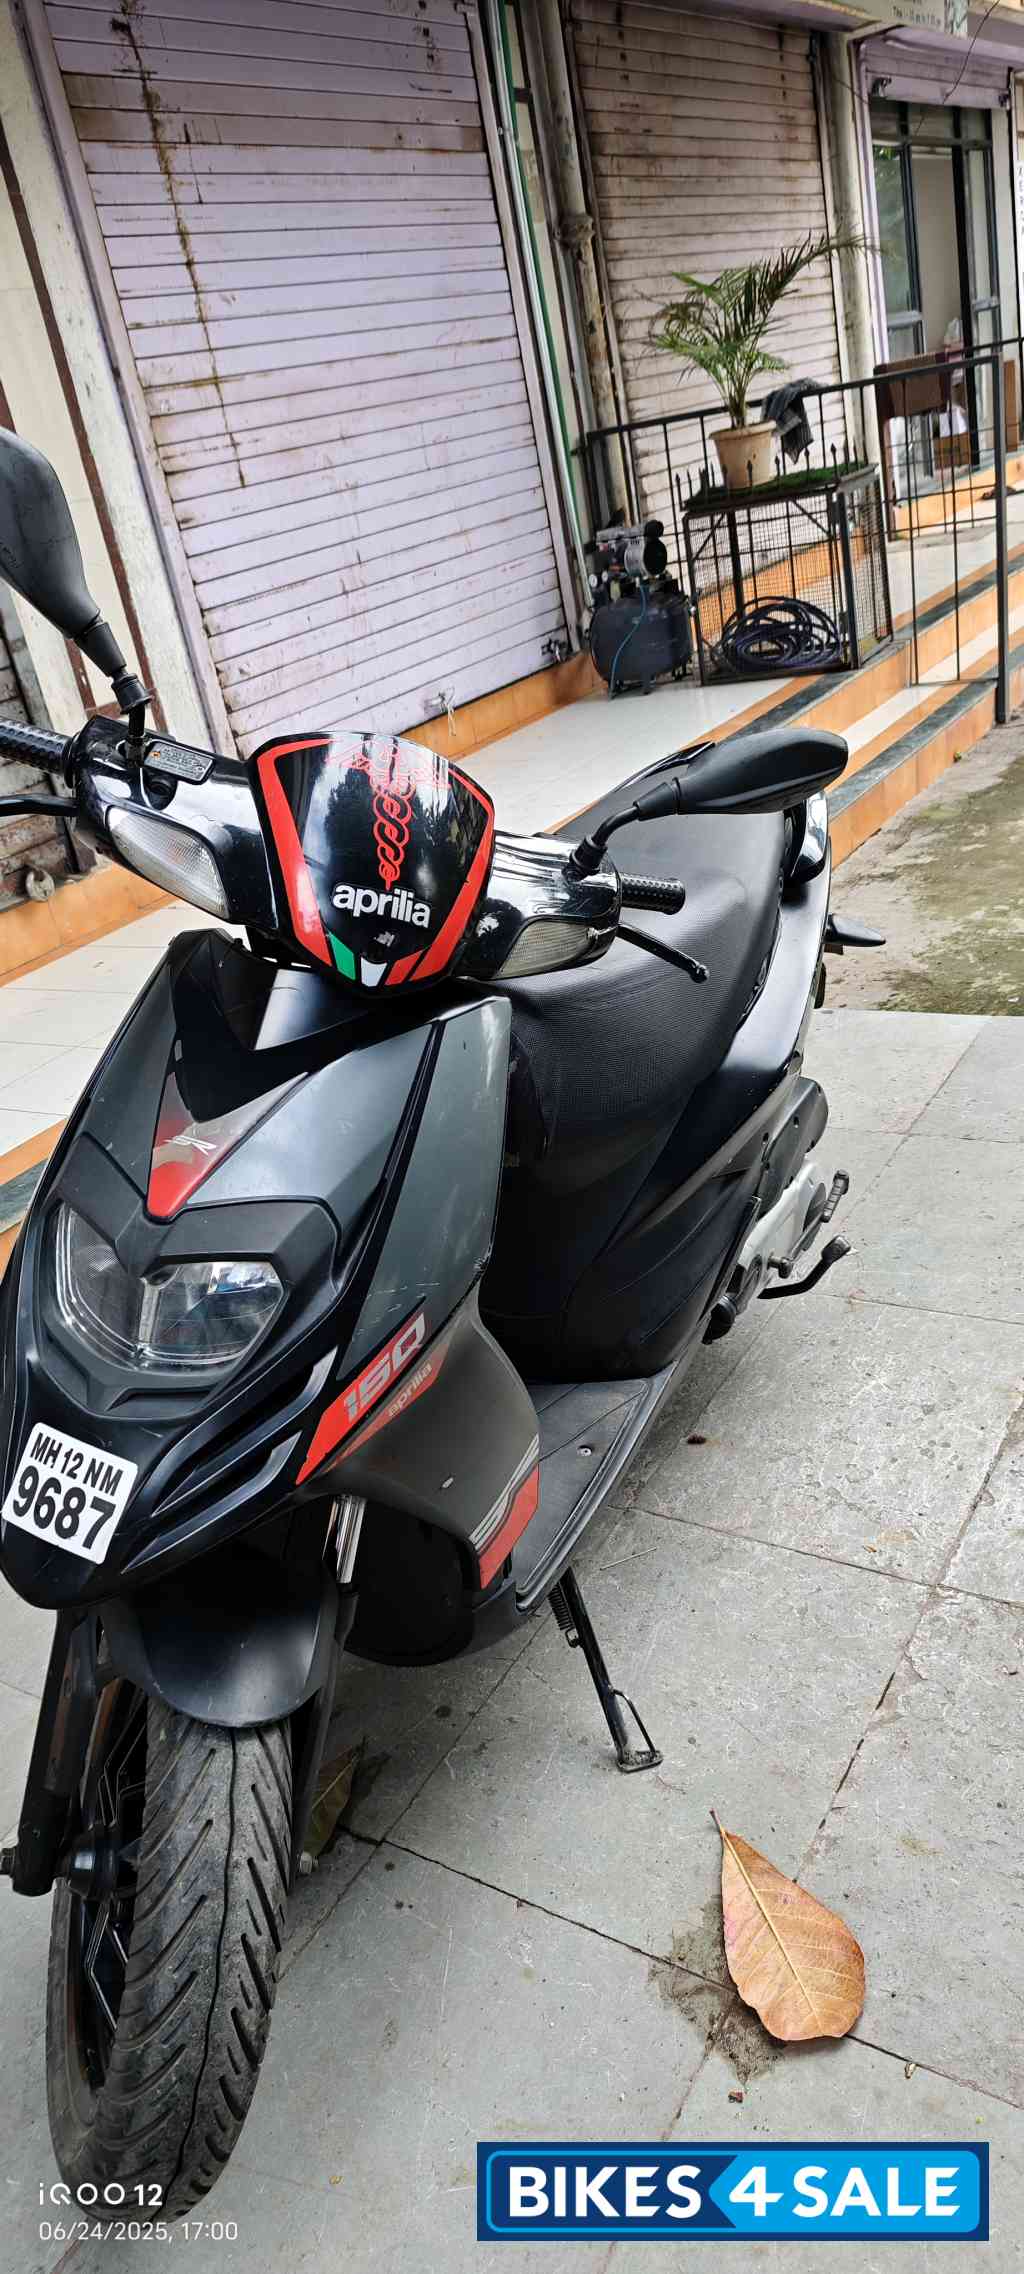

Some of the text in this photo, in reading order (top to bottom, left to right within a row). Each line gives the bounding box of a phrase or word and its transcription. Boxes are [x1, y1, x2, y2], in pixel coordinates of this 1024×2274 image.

[332, 884, 431, 928] aprilia
[30, 1432, 124, 1497] MH 12 NM
[13, 1465, 117, 1550] 9687
